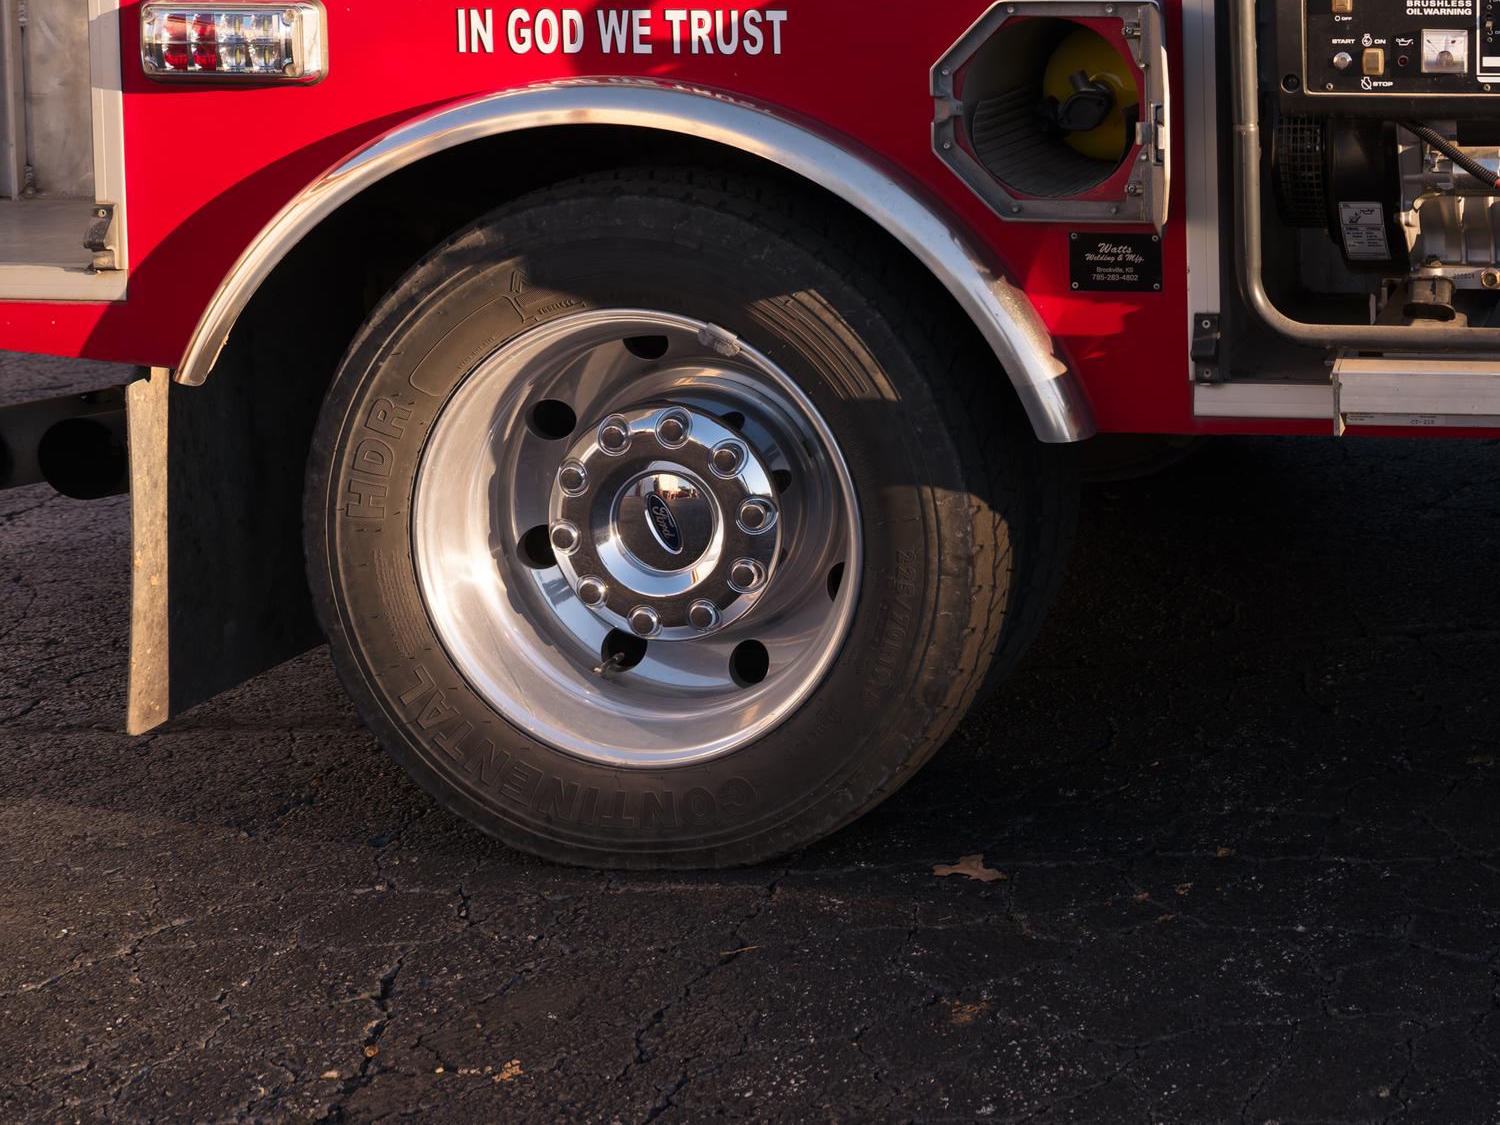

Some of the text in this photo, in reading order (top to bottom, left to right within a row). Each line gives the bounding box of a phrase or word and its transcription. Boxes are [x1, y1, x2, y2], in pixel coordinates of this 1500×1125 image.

[455, 8, 789, 56] IN GOD WE TRUST
[1084, 253, 1115, 263] Welding
[1125, 254, 1145, 263] Mfg.
[1098, 242, 1132, 254] Watts
[345, 397, 413, 519] HDR
[652, 506, 676, 539] Ford
[399, 664, 759, 829] CONTINENTAL
